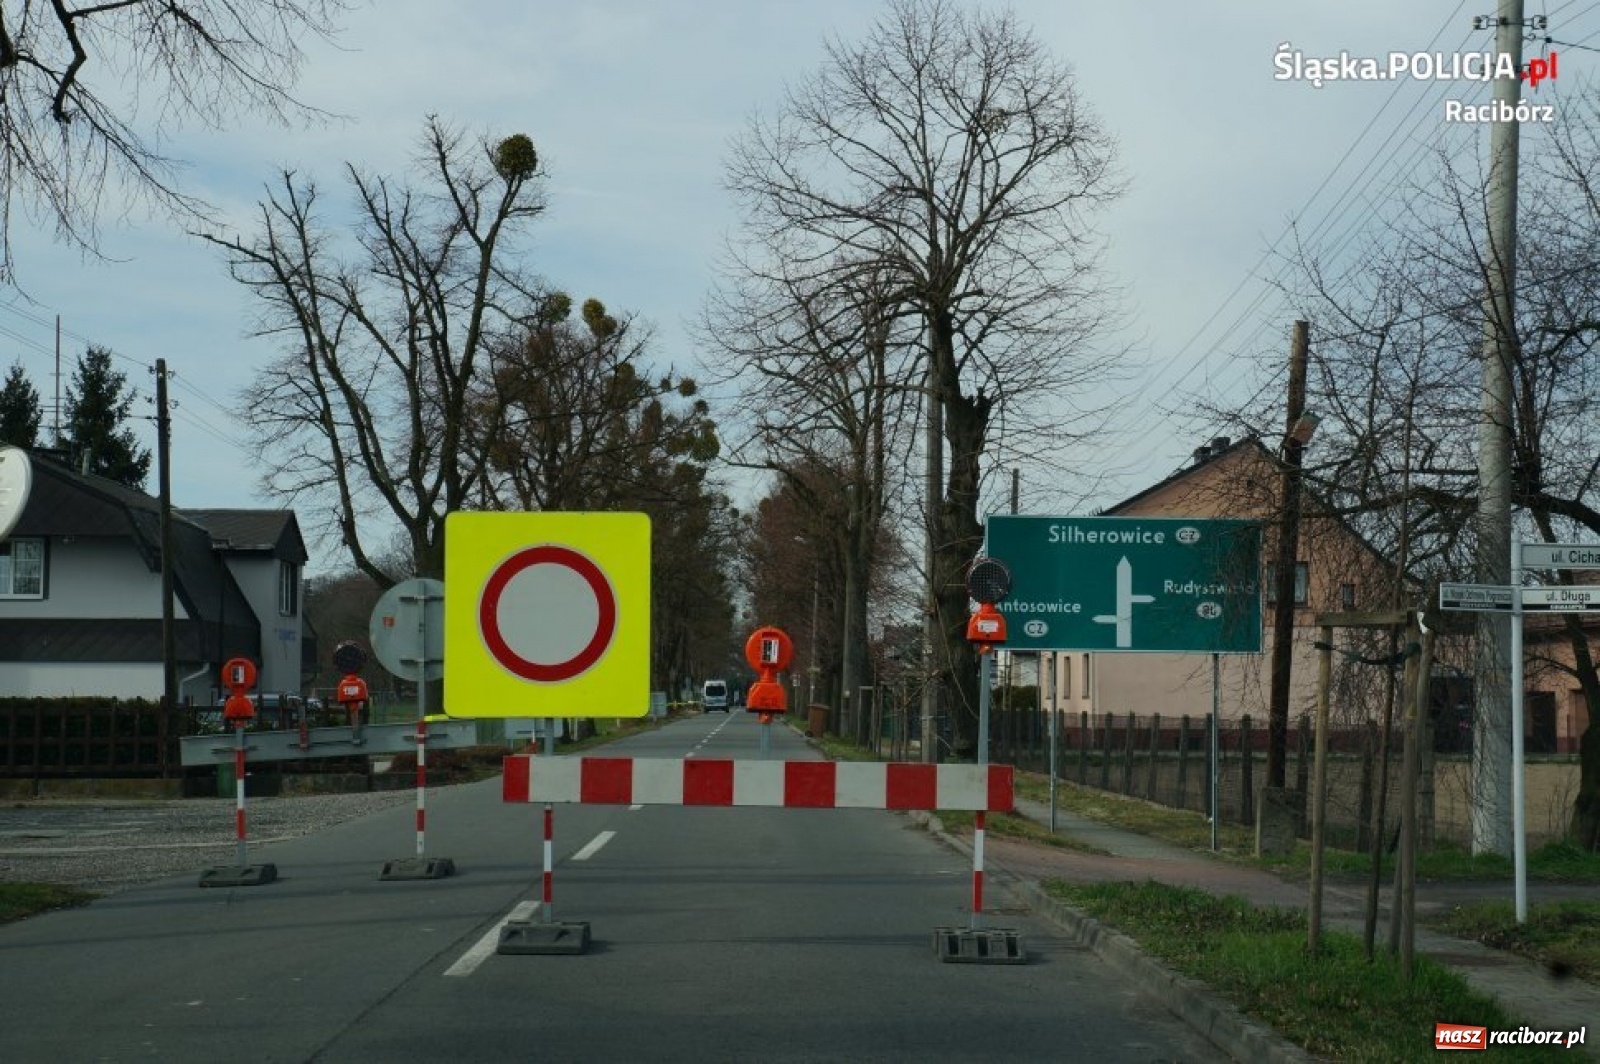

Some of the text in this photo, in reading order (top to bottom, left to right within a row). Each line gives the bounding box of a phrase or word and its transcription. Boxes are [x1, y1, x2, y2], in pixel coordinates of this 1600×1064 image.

[1049, 525, 1166, 545] Silherowice
[1561, 591, 1590, 605] Długa
[1027, 623, 1044, 634] CZ
